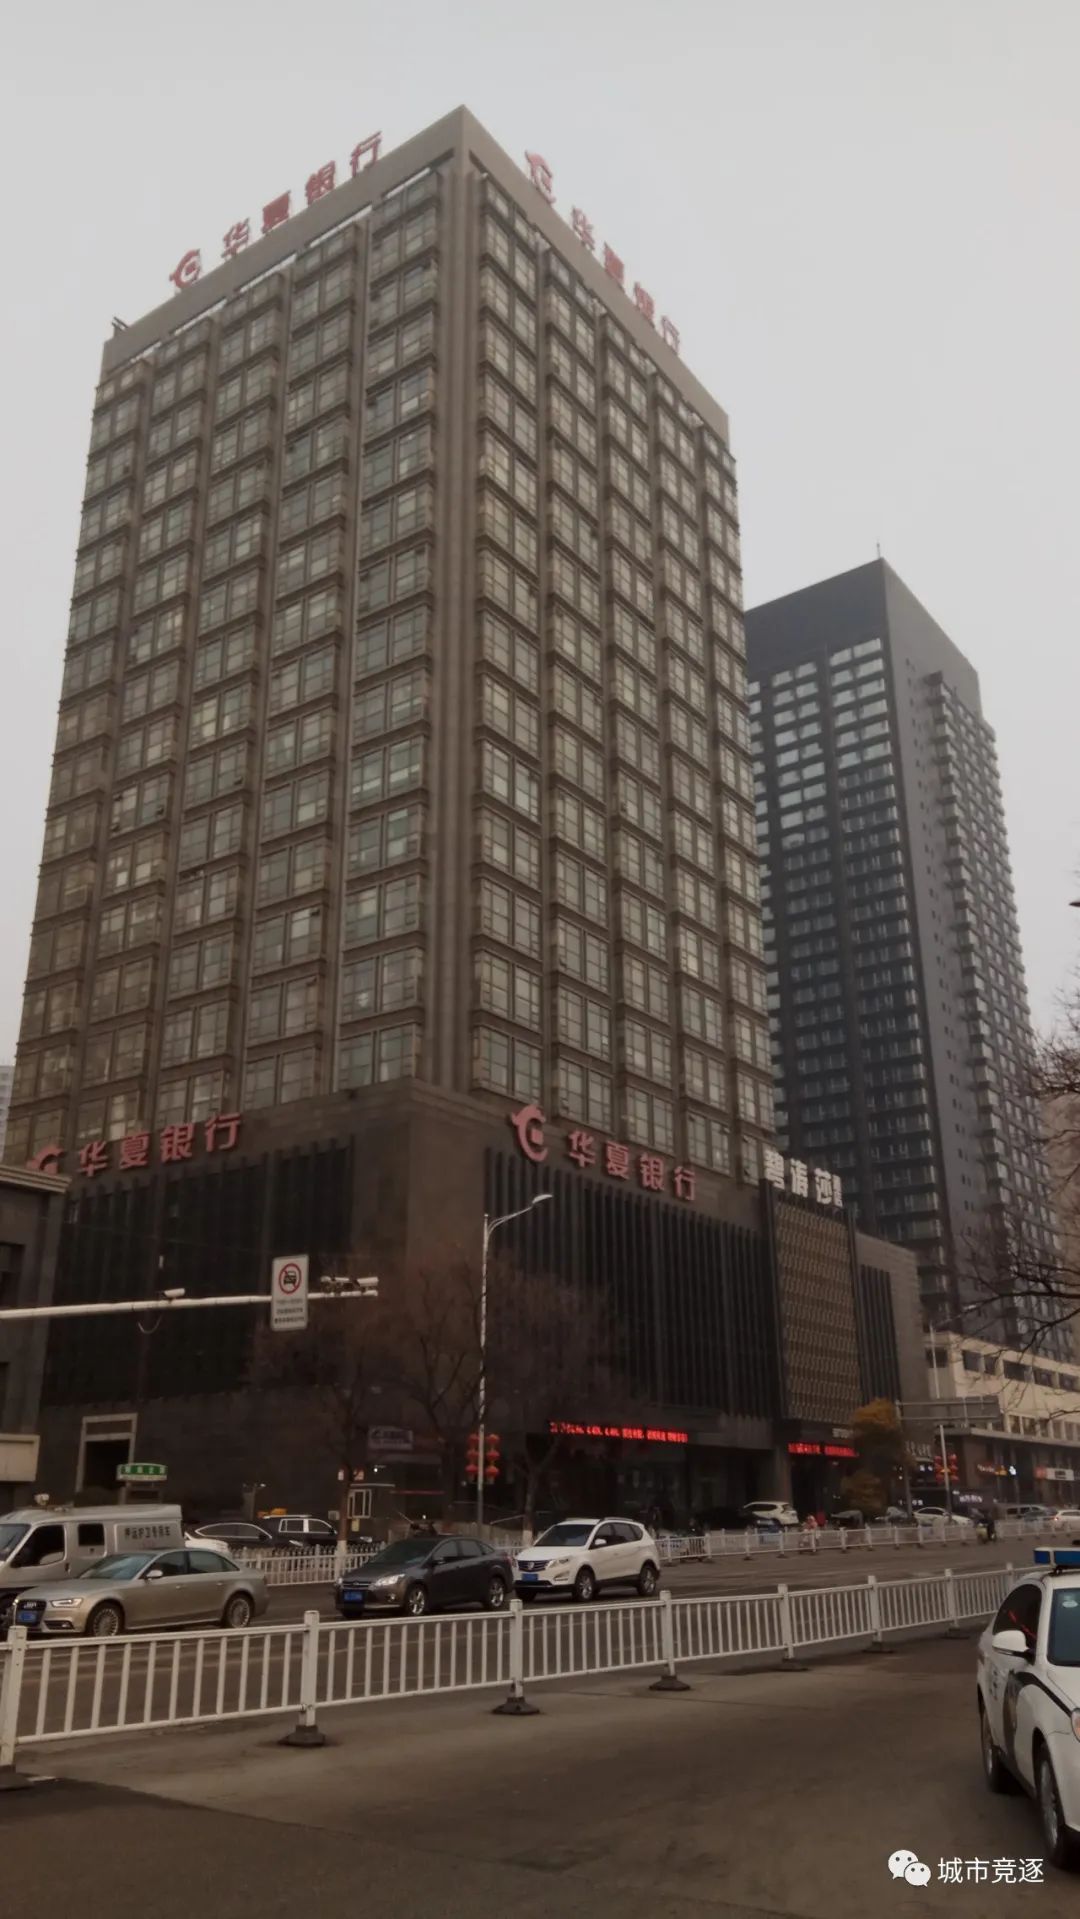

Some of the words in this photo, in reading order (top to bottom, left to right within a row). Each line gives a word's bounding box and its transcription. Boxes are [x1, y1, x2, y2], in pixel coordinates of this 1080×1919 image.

[220, 129, 382, 261] 华夏银行
[77, 1111, 241, 1177] 华夏银行
[568, 1129, 697, 1201] 华夏银行
